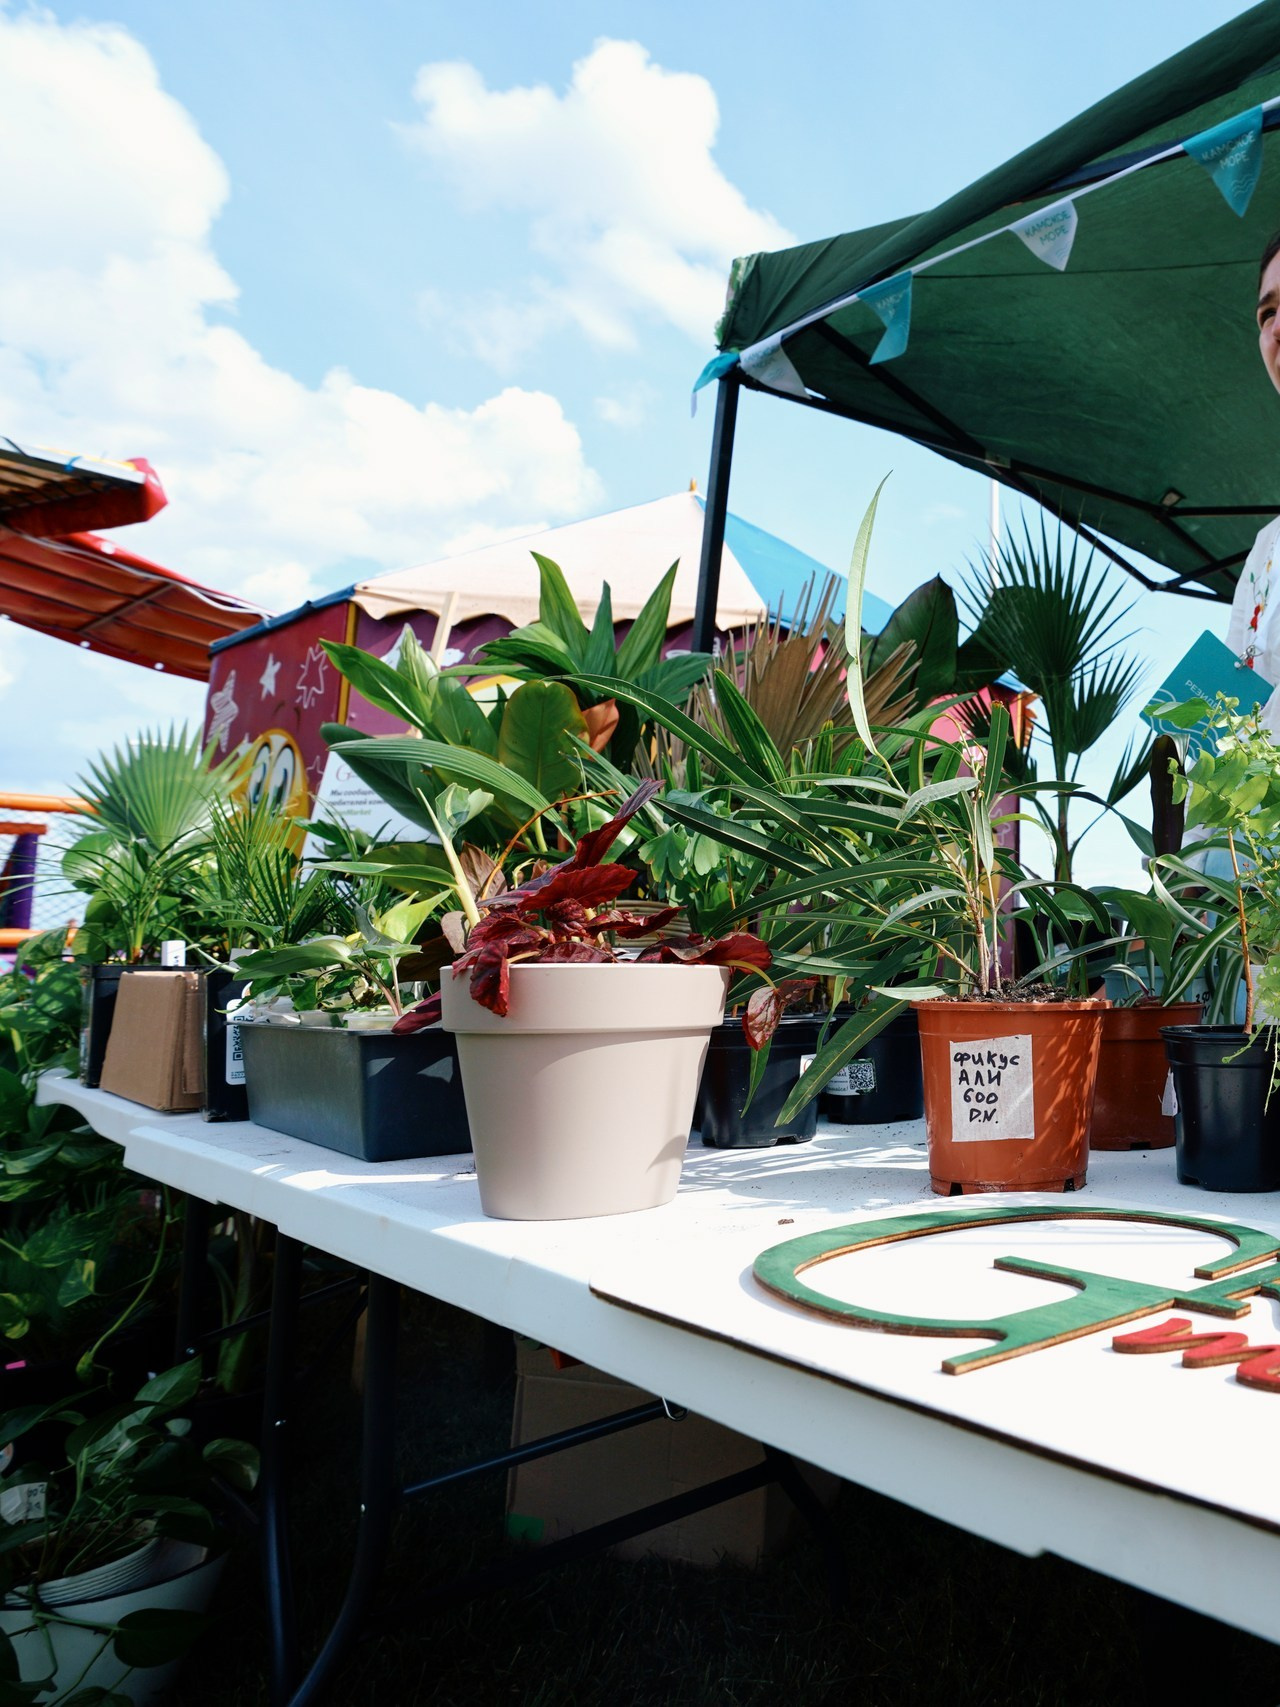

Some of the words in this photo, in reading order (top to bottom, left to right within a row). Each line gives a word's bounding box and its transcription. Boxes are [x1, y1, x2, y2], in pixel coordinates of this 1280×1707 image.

[1219, 150, 1249, 170] МОРЕ
[1040, 225, 1068, 245] МОРЕ
[958, 1068, 1001, 1087] АЛИ
[963, 1088, 999, 1105] 600
